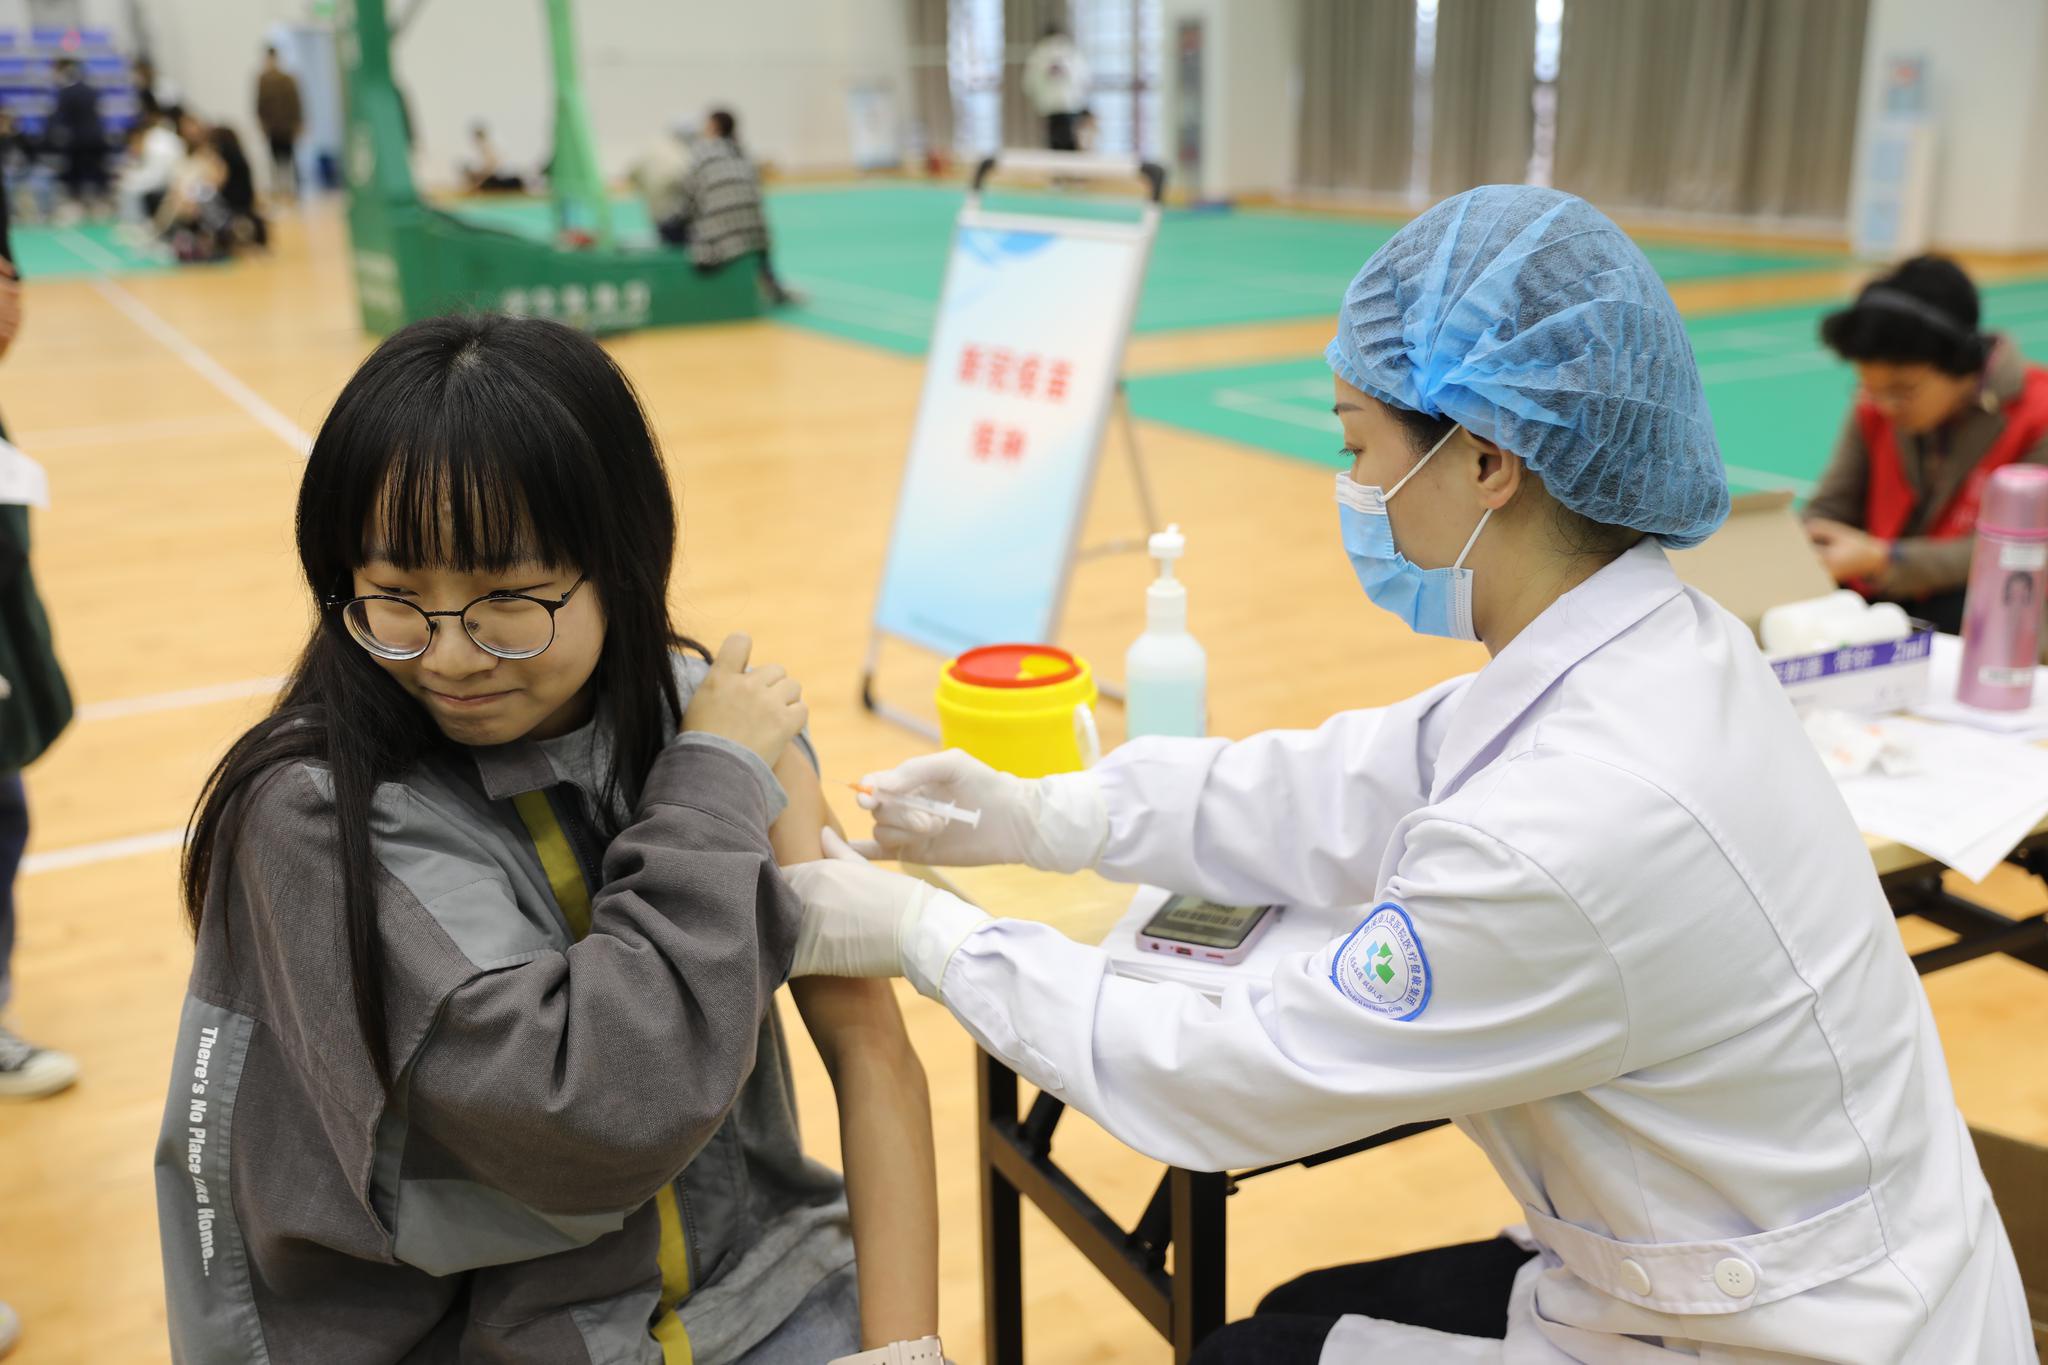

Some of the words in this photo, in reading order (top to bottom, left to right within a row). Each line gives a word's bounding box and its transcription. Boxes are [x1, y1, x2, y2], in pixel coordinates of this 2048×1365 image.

[192, 1026, 219, 1095] There's
[189, 1098, 207, 1123] No
[188, 1126, 206, 1174] Place
[197, 1207, 216, 1276] Home...
